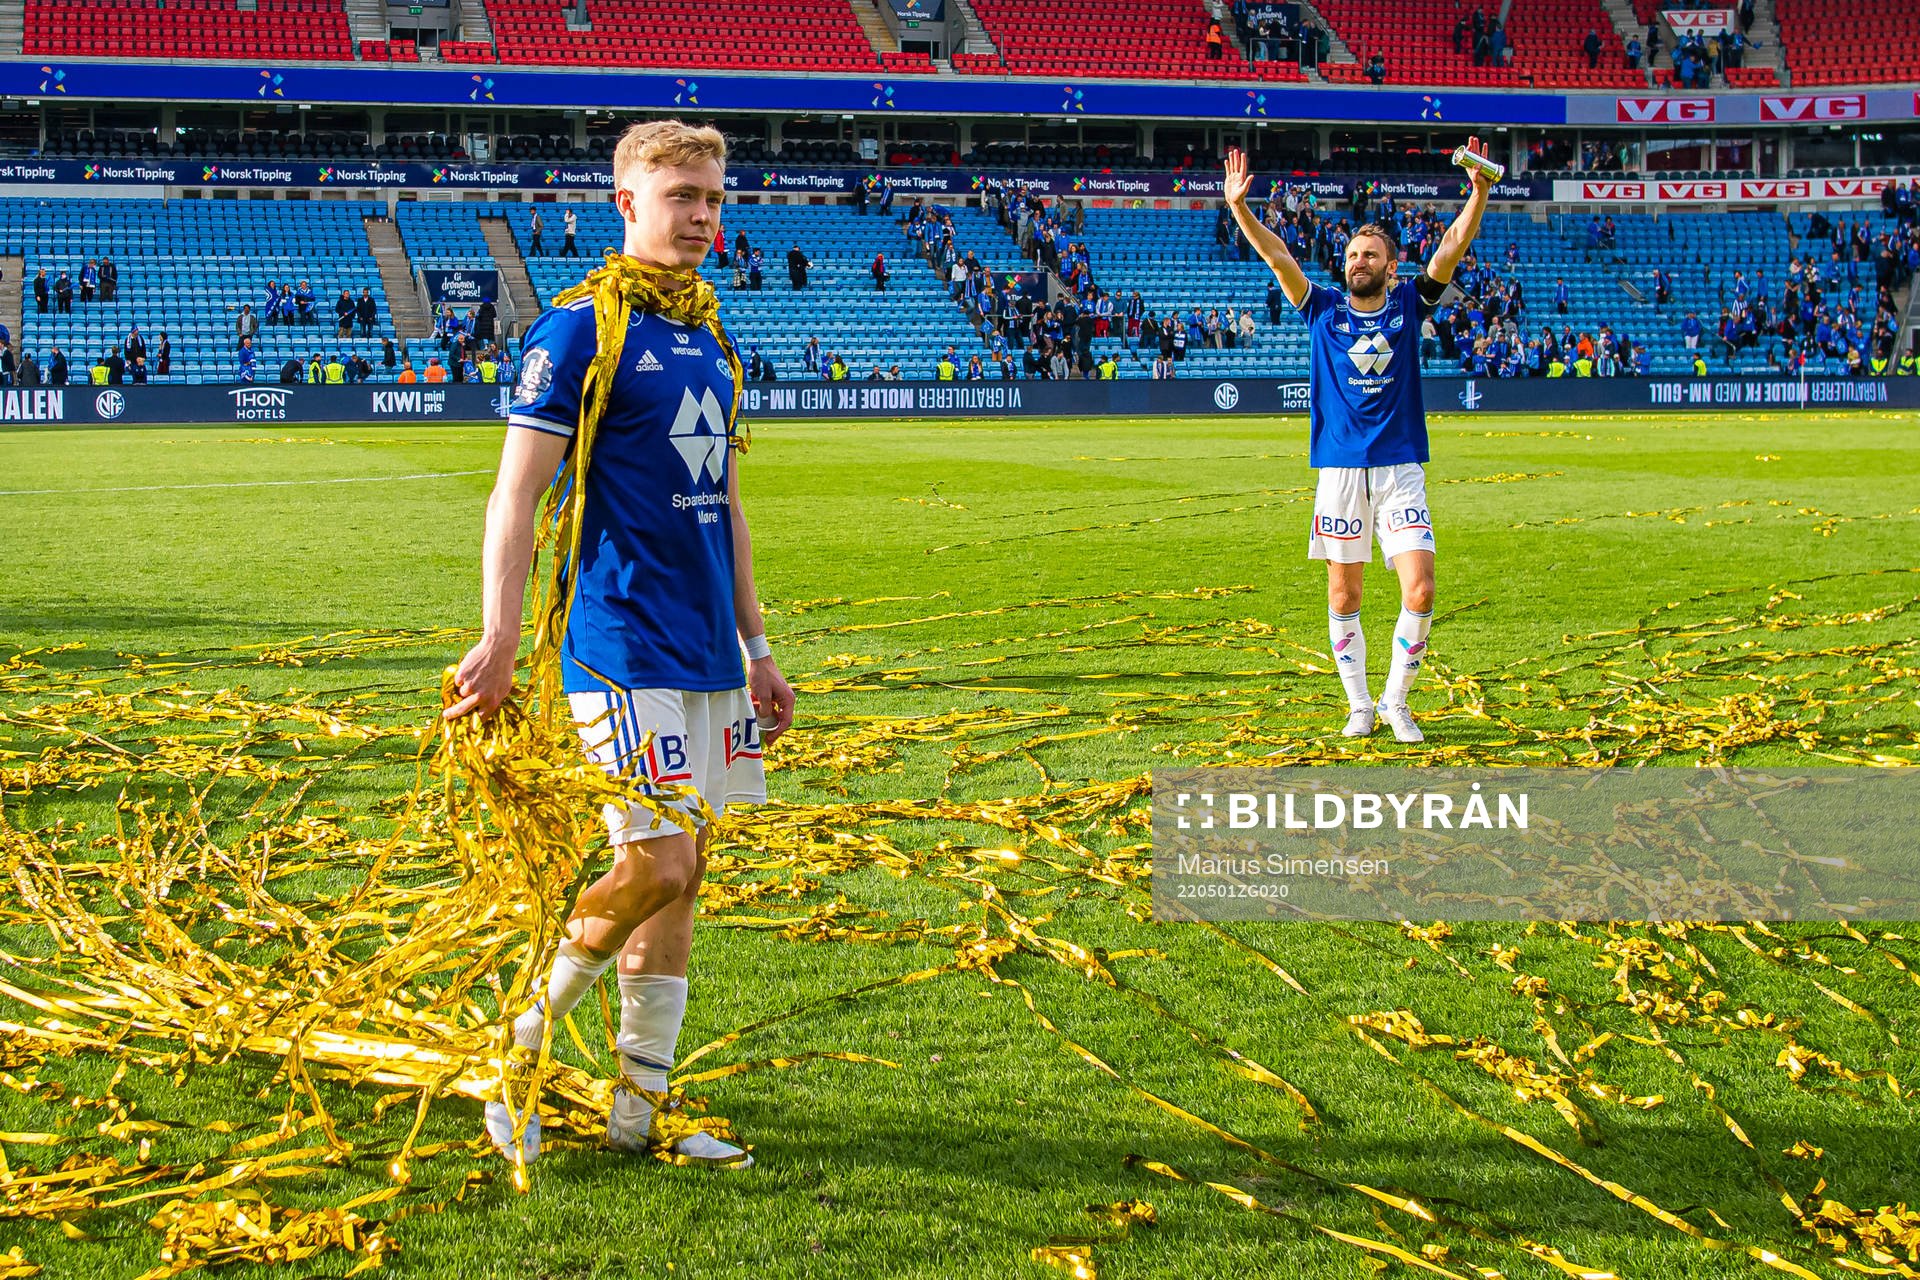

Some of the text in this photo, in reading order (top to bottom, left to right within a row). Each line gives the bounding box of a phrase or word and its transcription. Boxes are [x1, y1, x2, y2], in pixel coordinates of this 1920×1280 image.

[1669, 13, 1724, 25] VG
[1619, 100, 1711, 122] VG
[1762, 96, 1862, 120] VG
[15, 166, 56, 180] Tipping
[103, 167, 175, 181] Norsk Tipping
[221, 169, 292, 182] Norsk Tipping
[337, 170, 406, 183] Norsk Tipping
[450, 171, 518, 183] Norsk Tipping
[562, 172, 614, 184] Norsk Tipp
[779, 175, 844, 187] Norsk Tipping
[884, 177, 948, 189] Norsk Tipping
[988, 178, 1015, 188] Nok
[1089, 180, 1150, 192] Norsk Tipping
[1188, 181, 1215, 191] Norsk
[1311, 182, 1344, 195] Tipping
[1380, 183, 1438, 195] Norsk Tipping
[1499, 185, 1530, 197] Tipping
[1585, 184, 1642, 199] VG
[1660, 184, 1723, 199] VG
[1743, 183, 1806, 198] VG
[454, 272, 462, 281] Gi
[635, 363, 664, 372] adidas
[228, 387, 293, 407] THON
[424, 390, 445, 402] mini
[1277, 383, 1310, 398] THO
[373, 391, 421, 413] KIWI
[738, 389, 796, 410] NM-GU
[1283, 400, 1311, 408] HOTEL
[237, 409, 286, 419] HOTELS
[424, 402, 443, 415] pris
[672, 491, 729, 510] Sparebanke
[1392, 508, 1431, 526] BDO
[1322, 515, 1363, 535] BDO
[731, 717, 760, 752] BD
